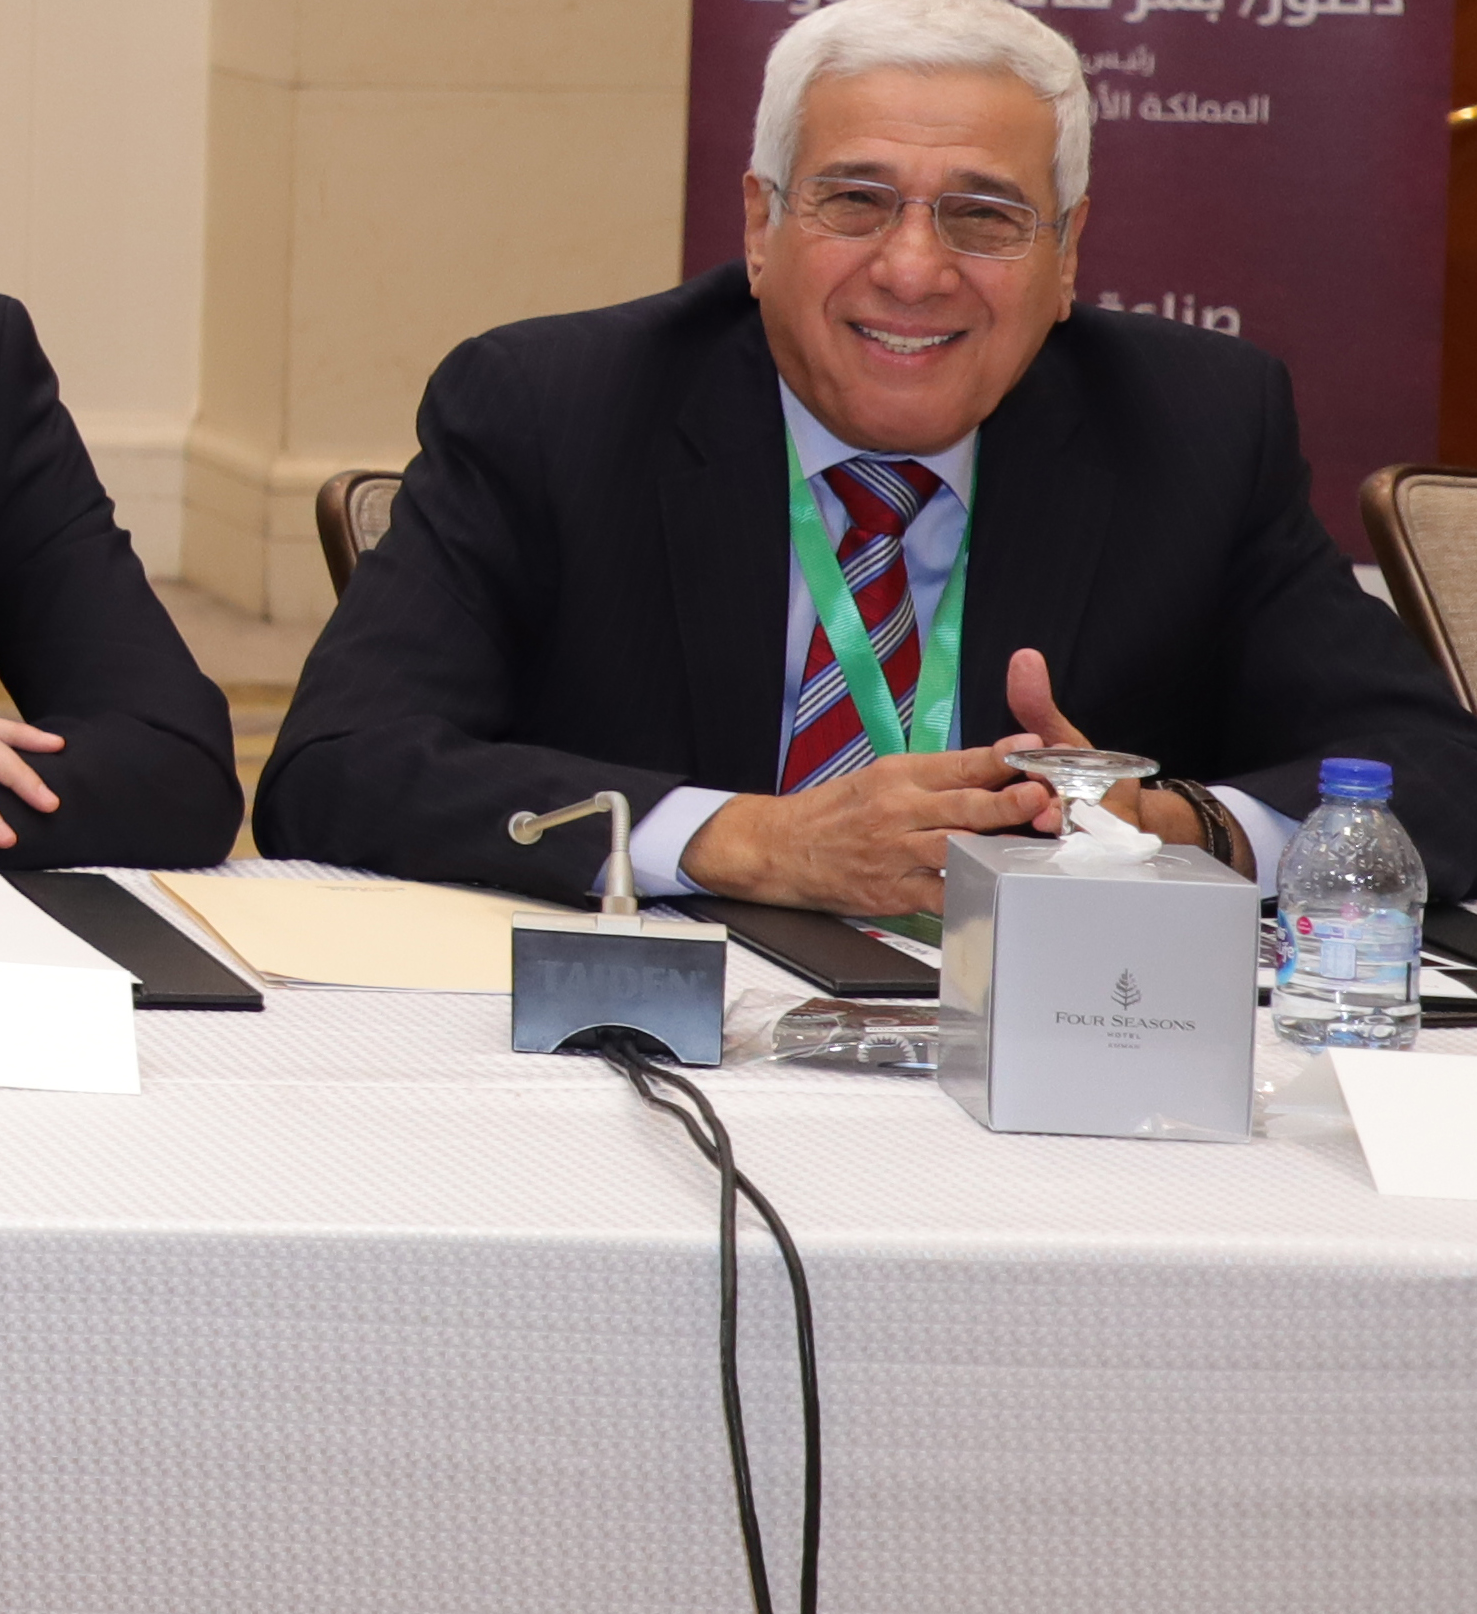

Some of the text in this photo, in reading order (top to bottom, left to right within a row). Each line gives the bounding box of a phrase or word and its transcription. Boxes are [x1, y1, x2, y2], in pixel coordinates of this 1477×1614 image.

[1081, 44, 1156, 77] رئيس
[1139, 92, 1270, 125] المملكة
[1055, 1011, 1197, 1031] FOUR SEASONS
[1107, 1031, 1142, 1040] HOTEL
